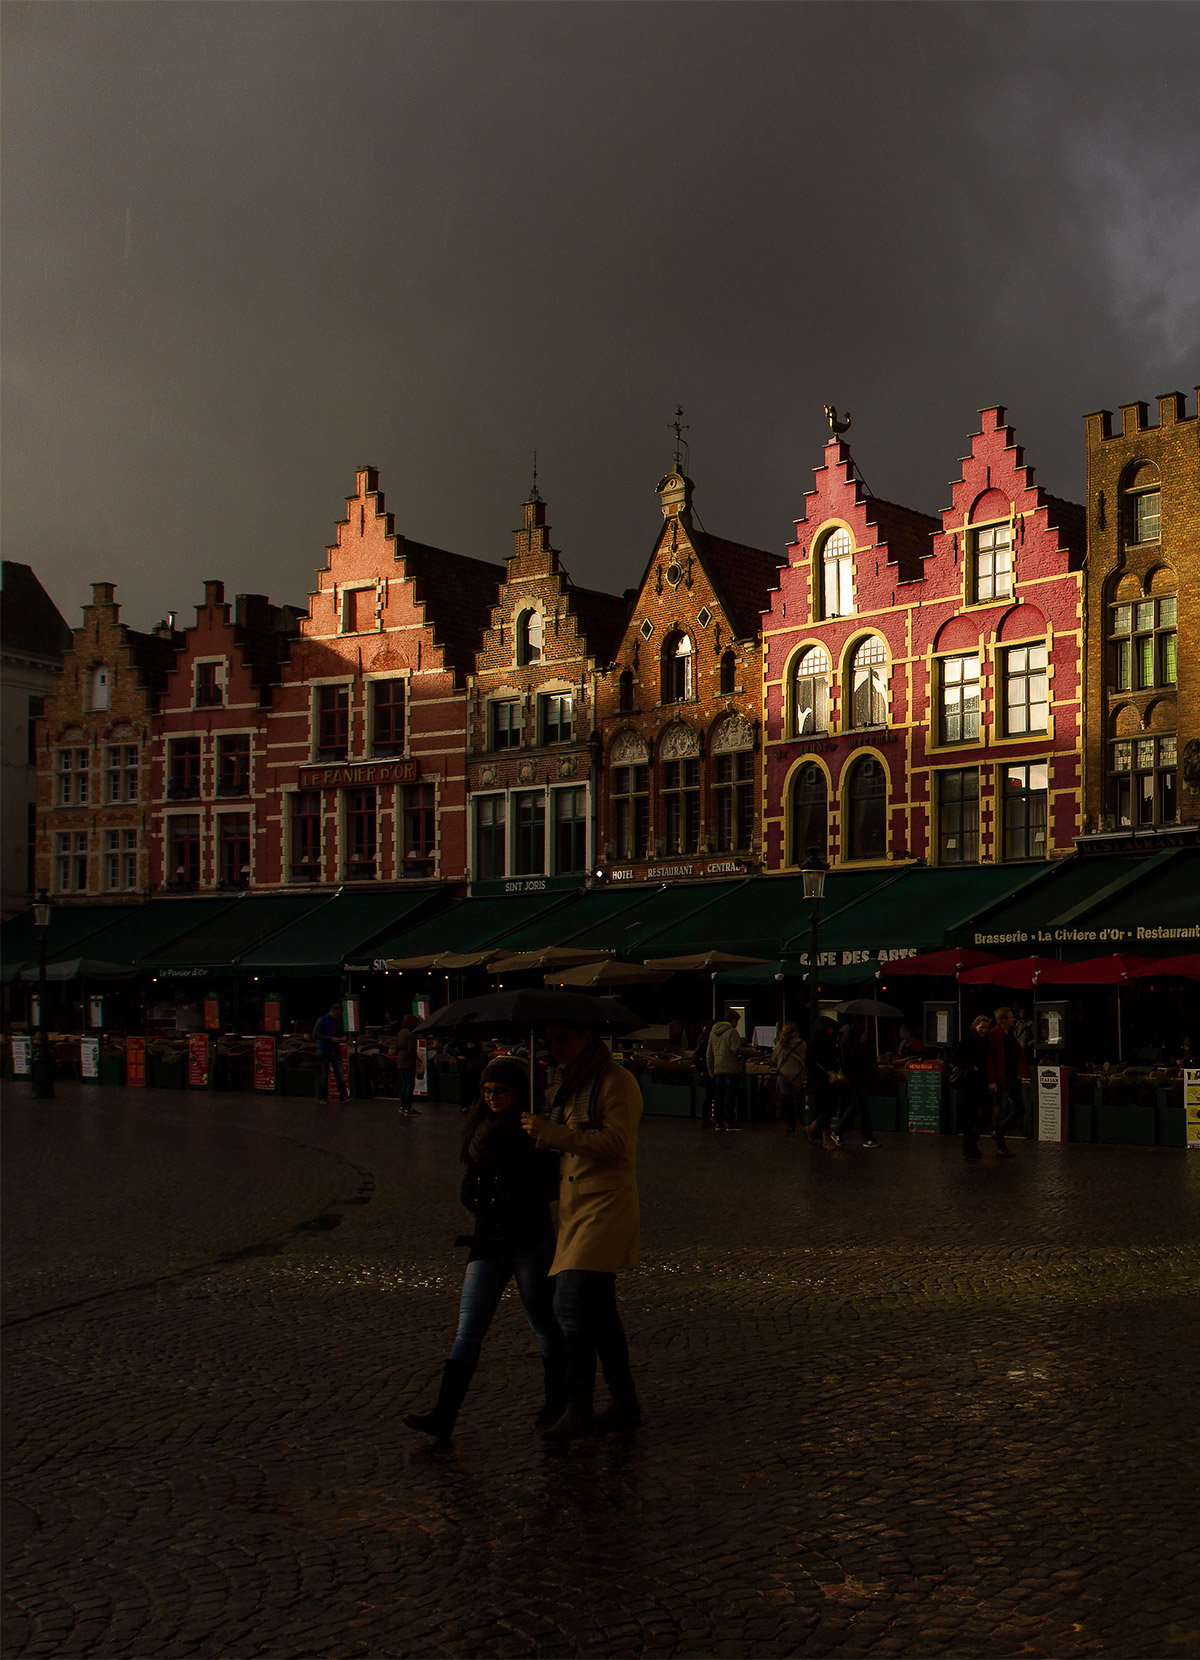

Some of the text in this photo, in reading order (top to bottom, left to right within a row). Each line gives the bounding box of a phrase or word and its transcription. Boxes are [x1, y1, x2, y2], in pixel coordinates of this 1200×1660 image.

[303, 774, 321, 786] LE
[324, 766, 376, 784] PANIER
[1081, 836, 1186, 854] RESTAURANT
[612, 870, 634, 880] HOTEL
[647, 865, 694, 877] RESTAURANT
[505, 880, 546, 892] SINT JORIS
[974, 924, 1200, 945] Brasserie La Civiere d'Or Restaurant
[800, 947, 918, 967] CFE DES ARTS
